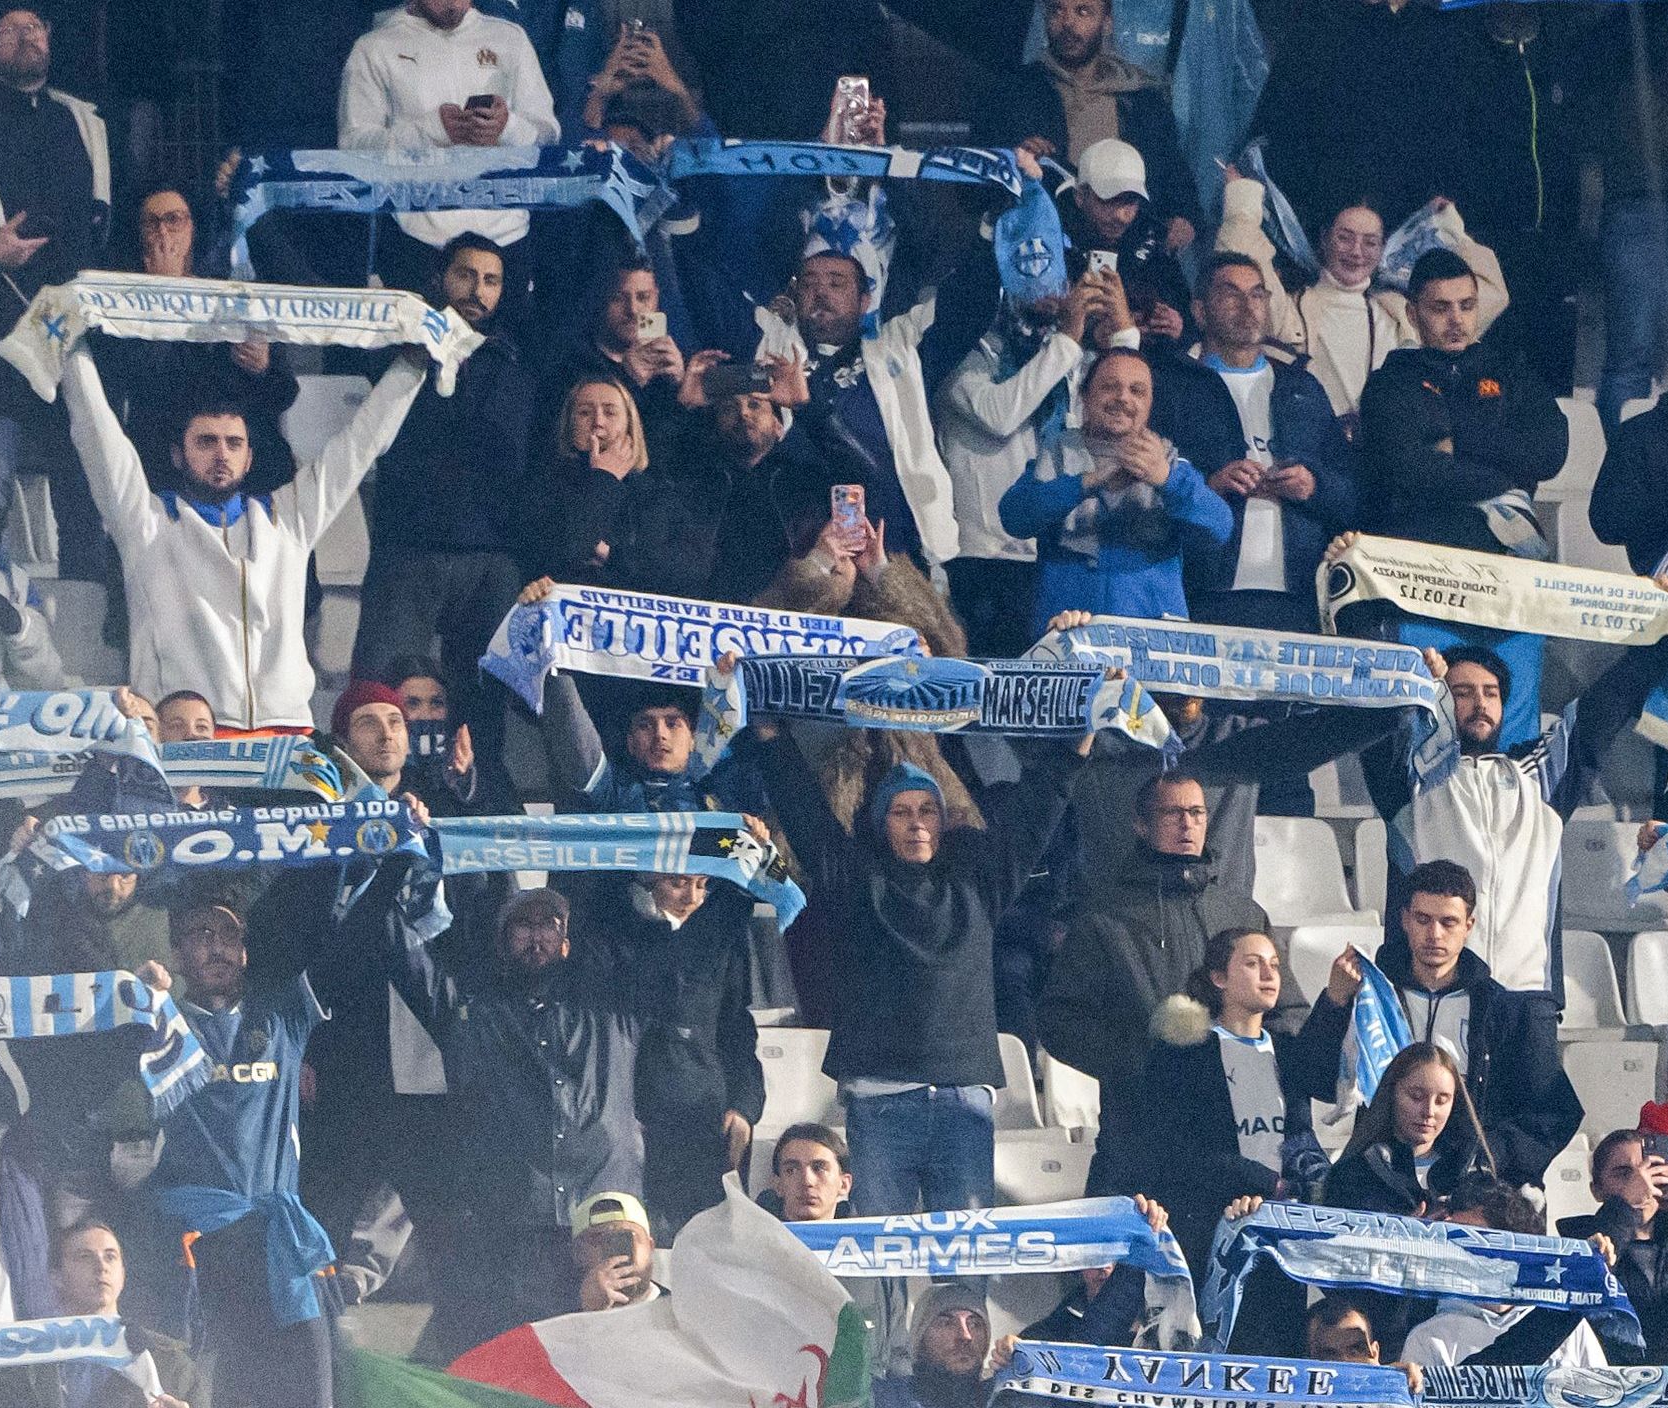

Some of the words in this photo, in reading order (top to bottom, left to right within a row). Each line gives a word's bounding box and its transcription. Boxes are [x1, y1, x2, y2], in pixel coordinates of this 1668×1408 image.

[580, 589, 711, 621] MARSEILLAIS
[981, 674, 1089, 728] MARSEILLE
[353, 801, 400, 819] 100
[825, 1232, 1059, 1269] ARMES
